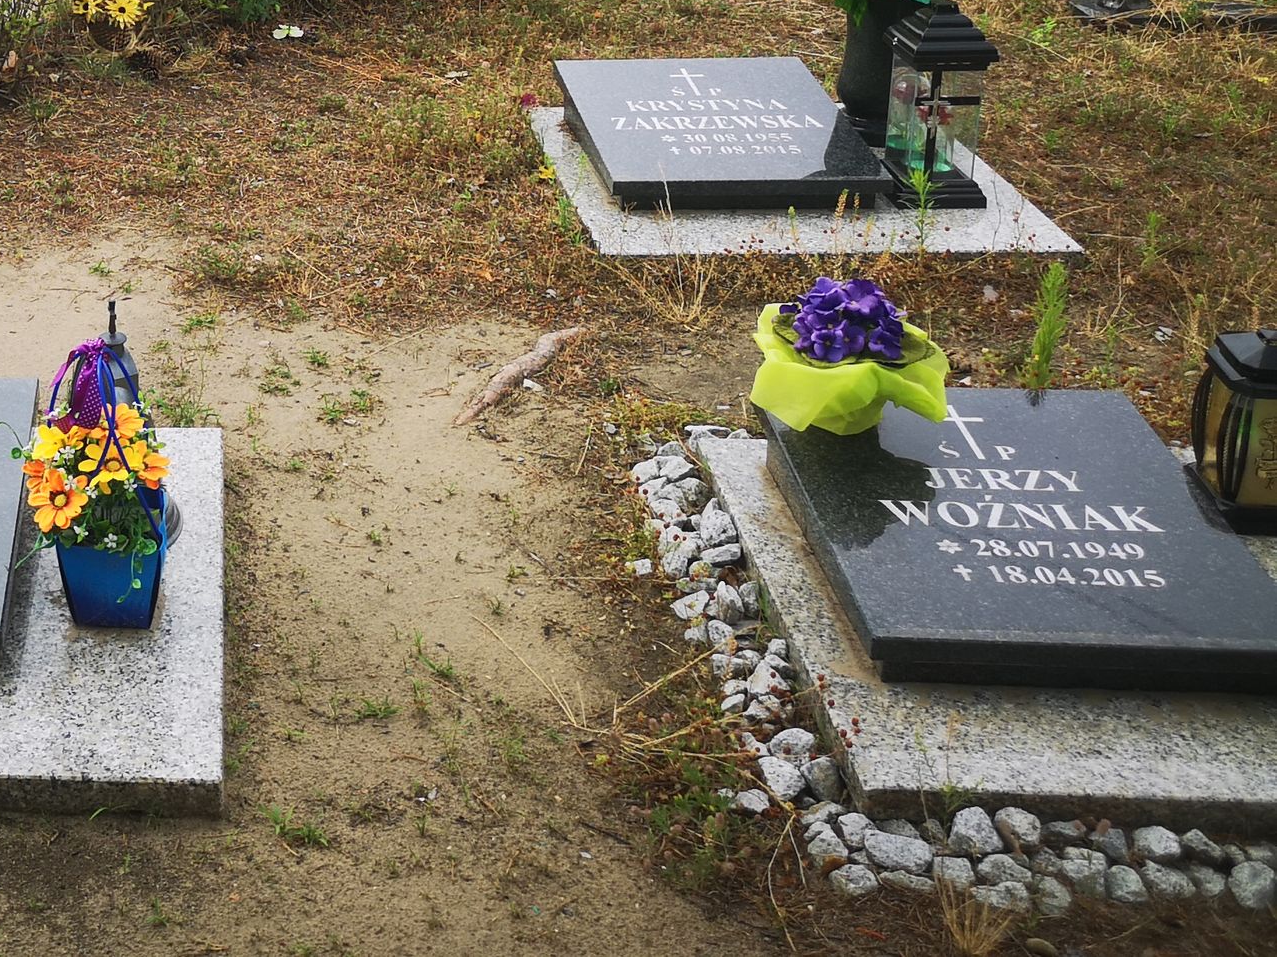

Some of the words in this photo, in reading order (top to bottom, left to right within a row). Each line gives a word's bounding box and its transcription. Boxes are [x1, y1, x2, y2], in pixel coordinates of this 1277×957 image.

[625, 98, 789, 113] KRYSTYNA
[610, 114, 825, 131] ZAKRZEWSKA
[689, 144, 803, 155] 07.08.2015
[937, 440, 962, 459] Ś
[994, 444, 1017, 461] P
[924, 466, 1085, 493] JERZY
[877, 494, 1167, 534] WOŹNIAK
[969, 538, 1146, 561] 28.07.1949
[986, 564, 1167, 590] 18.04.2015
